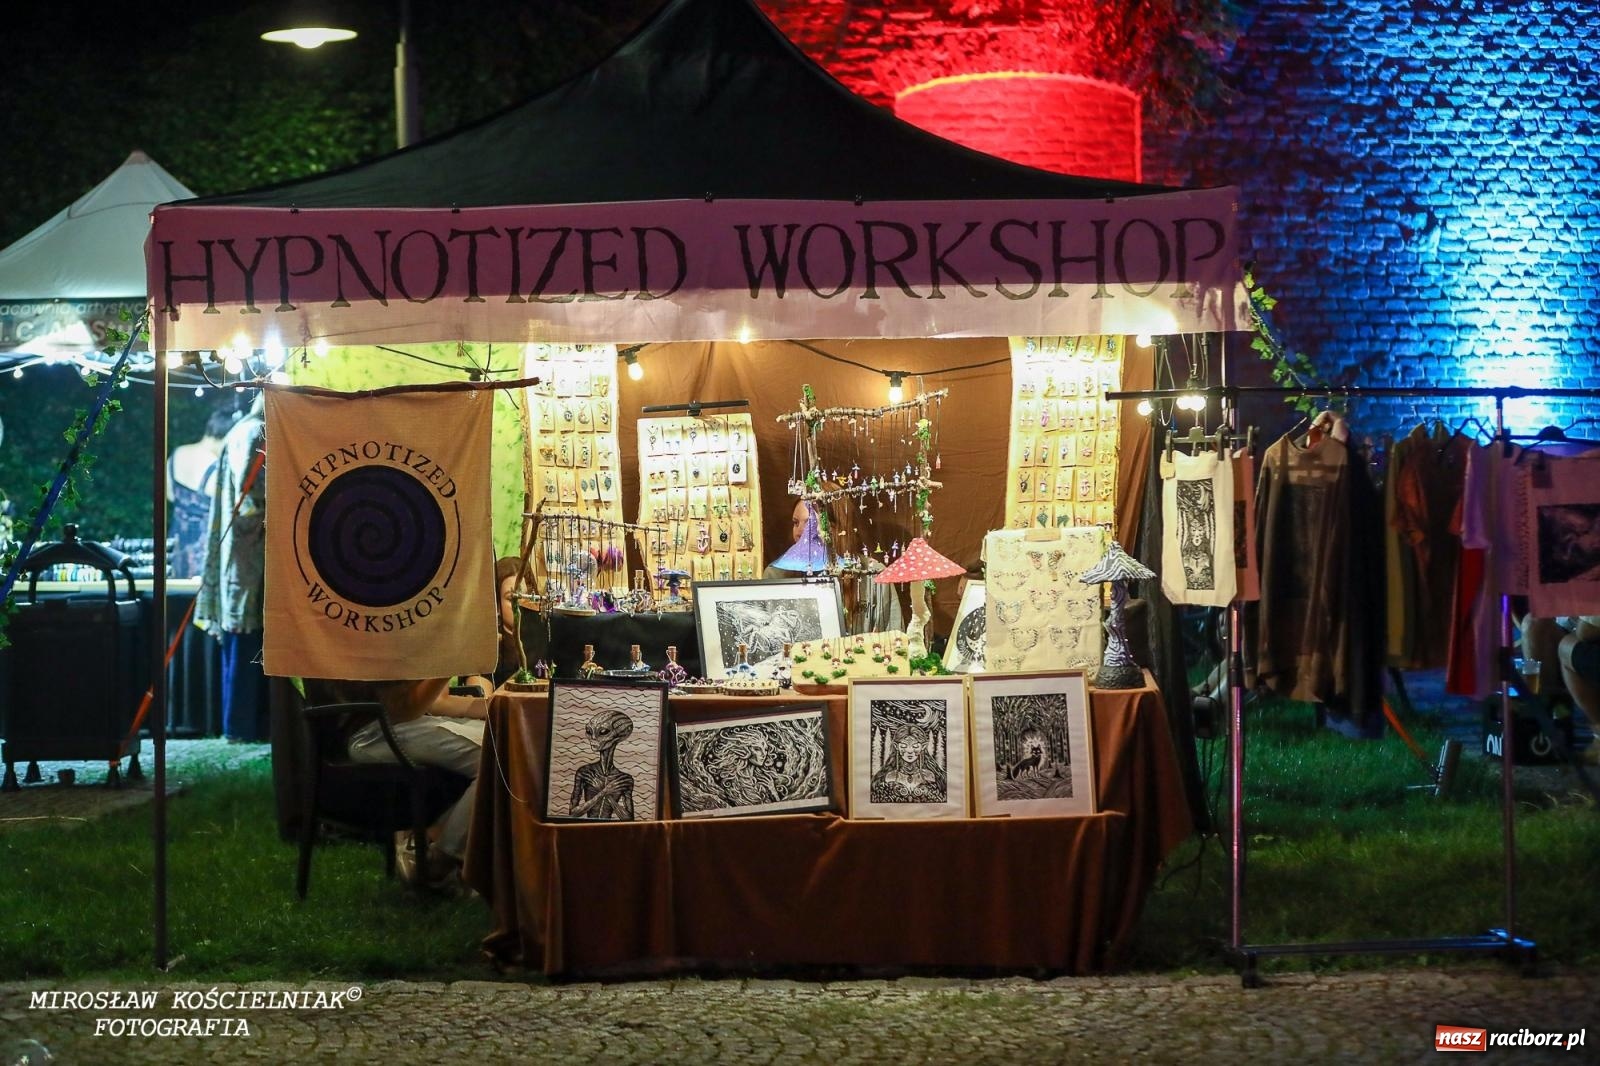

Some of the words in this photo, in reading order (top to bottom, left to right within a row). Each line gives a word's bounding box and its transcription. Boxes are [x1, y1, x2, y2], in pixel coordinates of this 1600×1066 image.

[158, 226, 688, 313] HYPNOTIZED
[734, 217, 1226, 300] WORKSHOP
[298, 440, 457, 499] HYPNOTIZED
[307, 582, 446, 633] WORKSHOP
